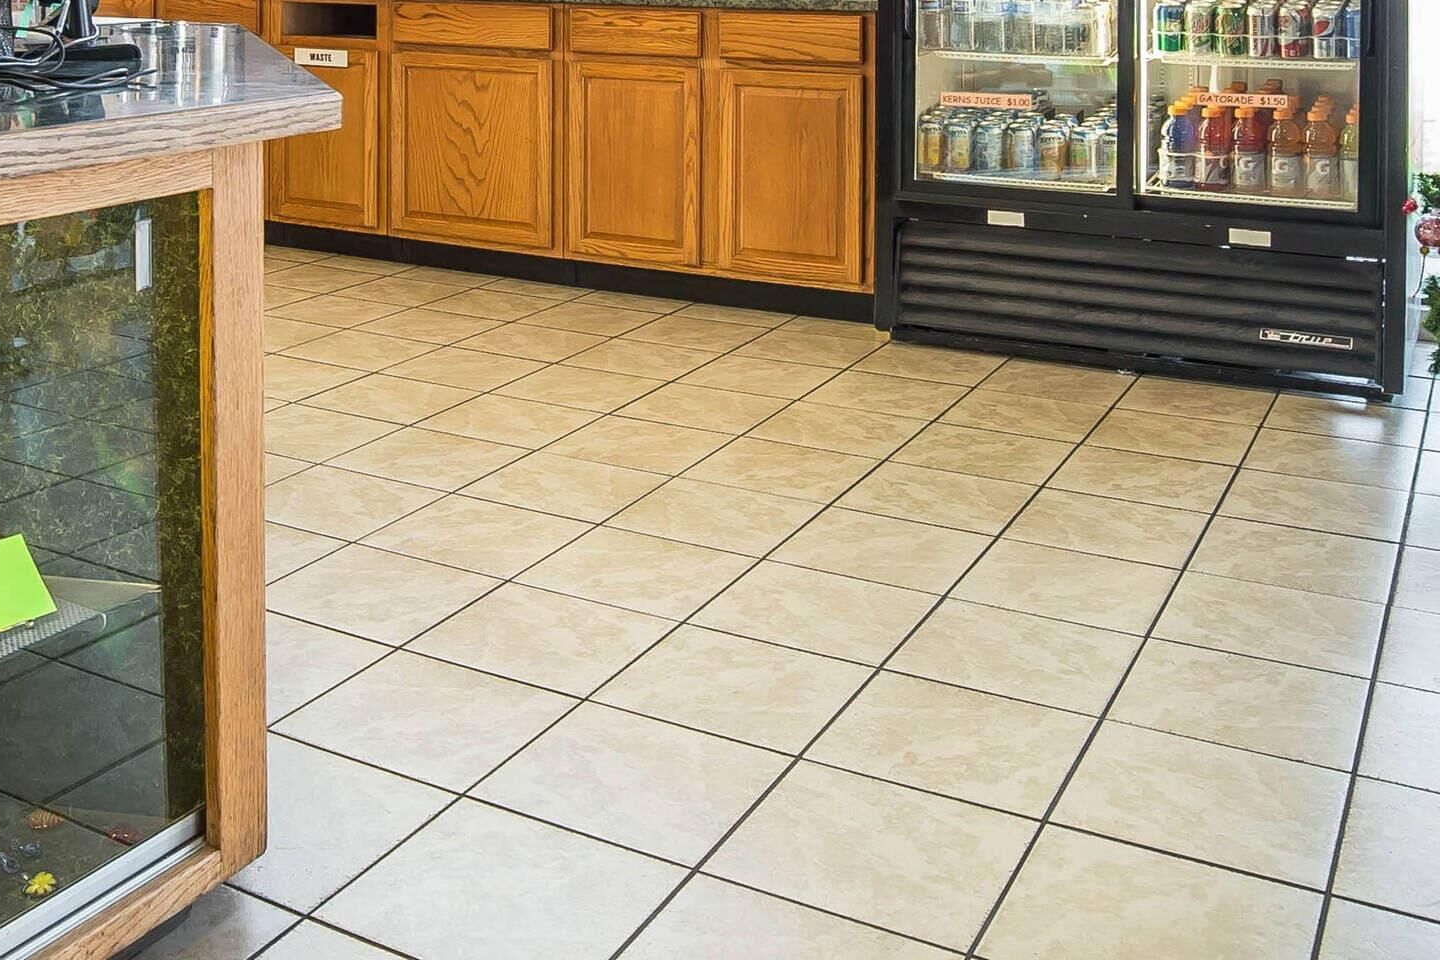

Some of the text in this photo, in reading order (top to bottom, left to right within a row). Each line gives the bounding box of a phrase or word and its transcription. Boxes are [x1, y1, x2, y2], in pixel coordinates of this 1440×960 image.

[309, 52, 333, 63] WASTE
[942, 95, 1030, 107] KERNS JUICE $1.00
[1199, 94, 1286, 106] GATORADE $1.50
[1315, 160, 1330, 174] G
